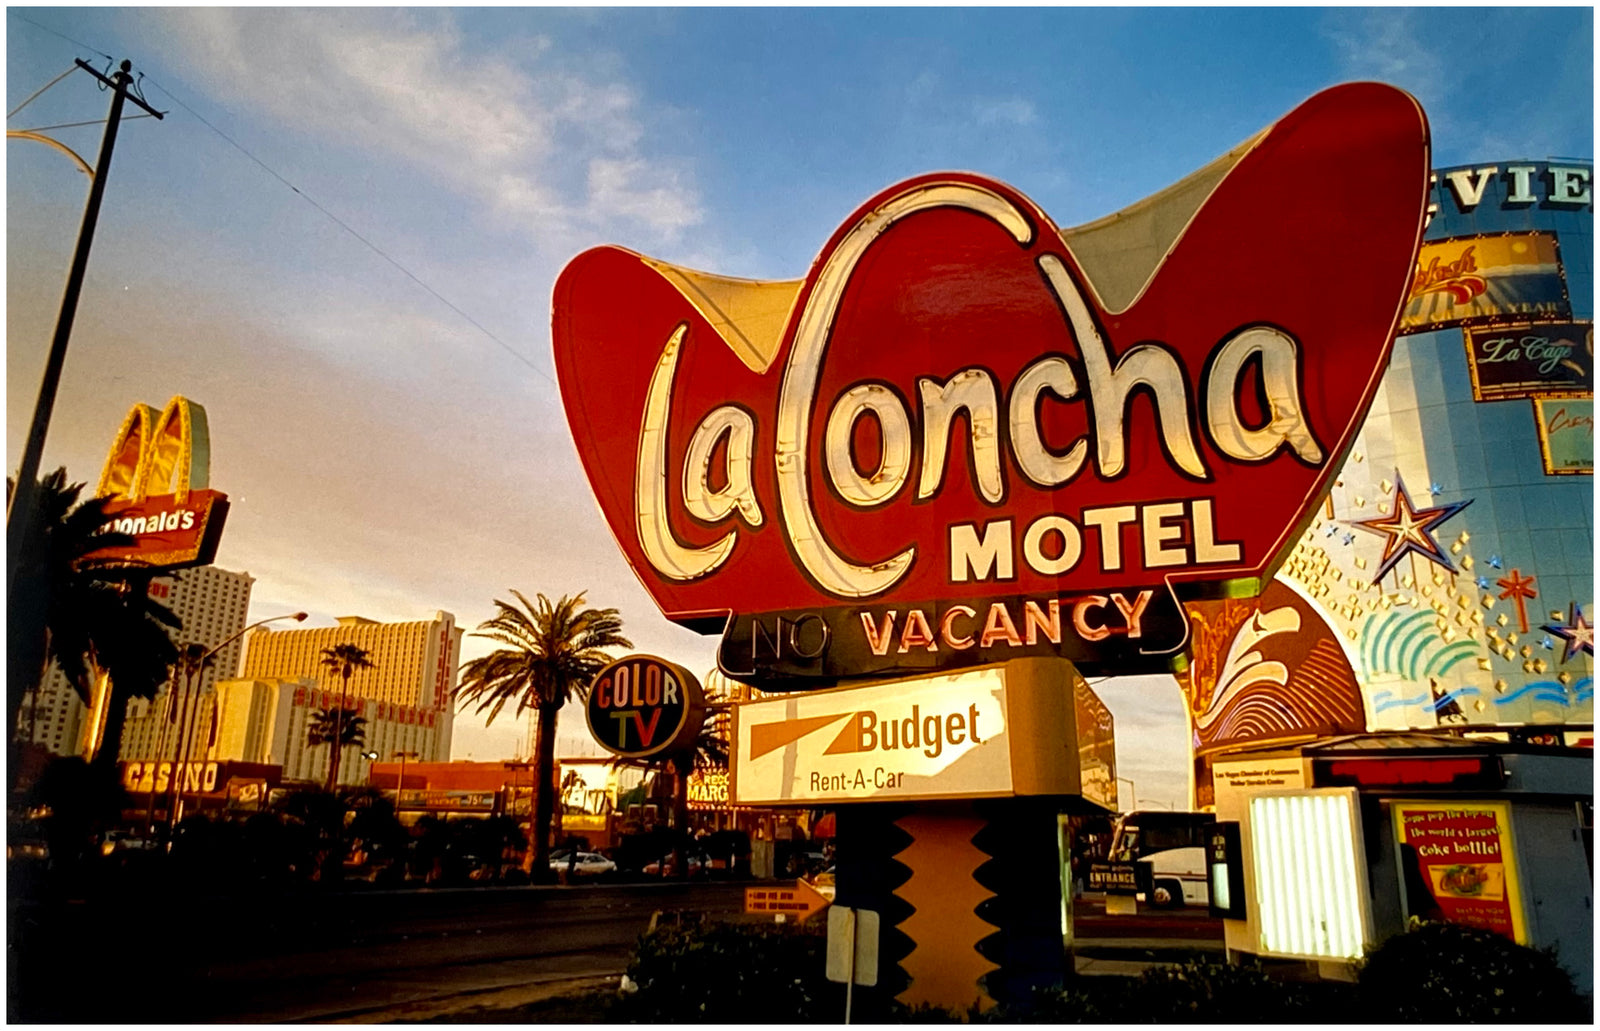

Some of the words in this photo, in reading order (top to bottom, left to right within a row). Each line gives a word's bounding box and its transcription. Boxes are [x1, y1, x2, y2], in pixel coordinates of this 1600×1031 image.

[1430, 165, 1591, 210] VIE
[1477, 338, 1520, 364] La
[1520, 336, 1572, 374] Cage
[635, 323, 761, 581] La
[776, 181, 1322, 597] Concha
[950, 499, 1241, 583] MOTEL
[752, 612, 830, 659] NO
[860, 590, 1154, 656] VACANCY
[597, 662, 679, 708] COLOR
[610, 708, 662, 748] TV
[857, 703, 981, 758] Budget
[125, 762, 218, 793] CASINO
[810, 767, 905, 793] Rent-A-Car
[1418, 842, 1450, 857] Coke
[1090, 872, 1136, 884] ENTRANCE
